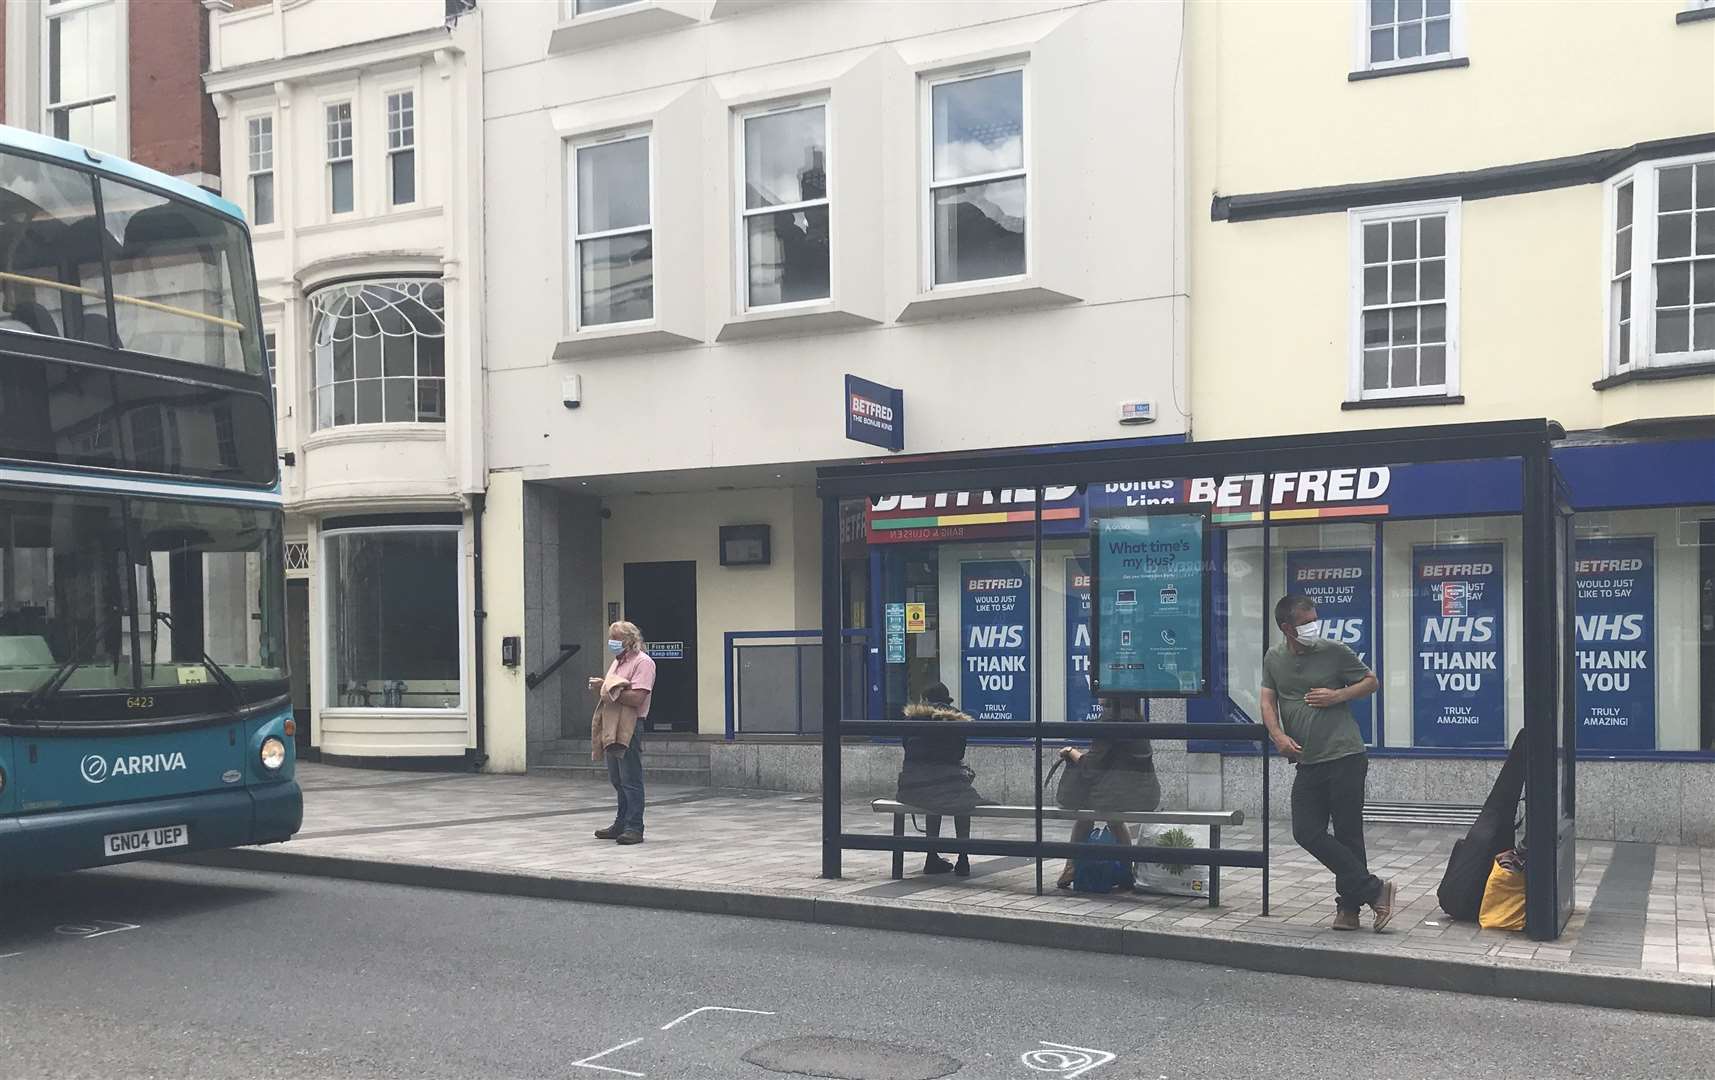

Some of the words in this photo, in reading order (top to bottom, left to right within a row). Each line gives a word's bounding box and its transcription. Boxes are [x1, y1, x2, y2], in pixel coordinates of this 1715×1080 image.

[852, 397, 893, 421] BETFRED
[1189, 466, 1391, 507] BETFRED
[1108, 540, 1147, 554] What
[1148, 538, 1190, 552] time's
[1122, 557, 1143, 569] my
[1146, 553, 1175, 567] bus?
[1296, 567, 1362, 580] BETFRED
[1423, 563, 1493, 577] BETFRED
[969, 578, 1023, 590] BETFRED
[1304, 586, 1334, 595] WOULD
[1335, 586, 1355, 594] JUST
[1468, 583, 1486, 591] UST
[1576, 579, 1611, 589] WOULD
[1612, 579, 1635, 588] JUST
[975, 595, 999, 603] WOULD
[1001, 595, 1016, 603] JUST
[1325, 595, 1336, 604] TO
[1337, 595, 1353, 603] SAY
[1578, 590, 1598, 598] LIKE
[1600, 590, 1613, 598] TO
[1614, 589, 1632, 598] SAY
[976, 604, 990, 612] LIKE
[1423, 617, 1494, 642] NHS
[1575, 614, 1644, 641] NHS
[969, 625, 1024, 648] NHS
[966, 655, 1026, 672] THANK
[1419, 651, 1497, 670] THANK
[978, 674, 1014, 691] YOU
[1435, 673, 1481, 691] YOU
[1582, 673, 1630, 692] YOU
[127, 696, 154, 708] 6423
[979, 712, 1013, 720] AMAZING!
[1444, 706, 1472, 715] TRULY
[1591, 707, 1620, 716] TRULY
[1436, 716, 1480, 724] AMAZING!
[1583, 717, 1629, 726] AMAZING!
[111, 752, 187, 776] ARRIVA
[110, 834, 150, 852] GN04
[154, 827, 182, 846] UEP
